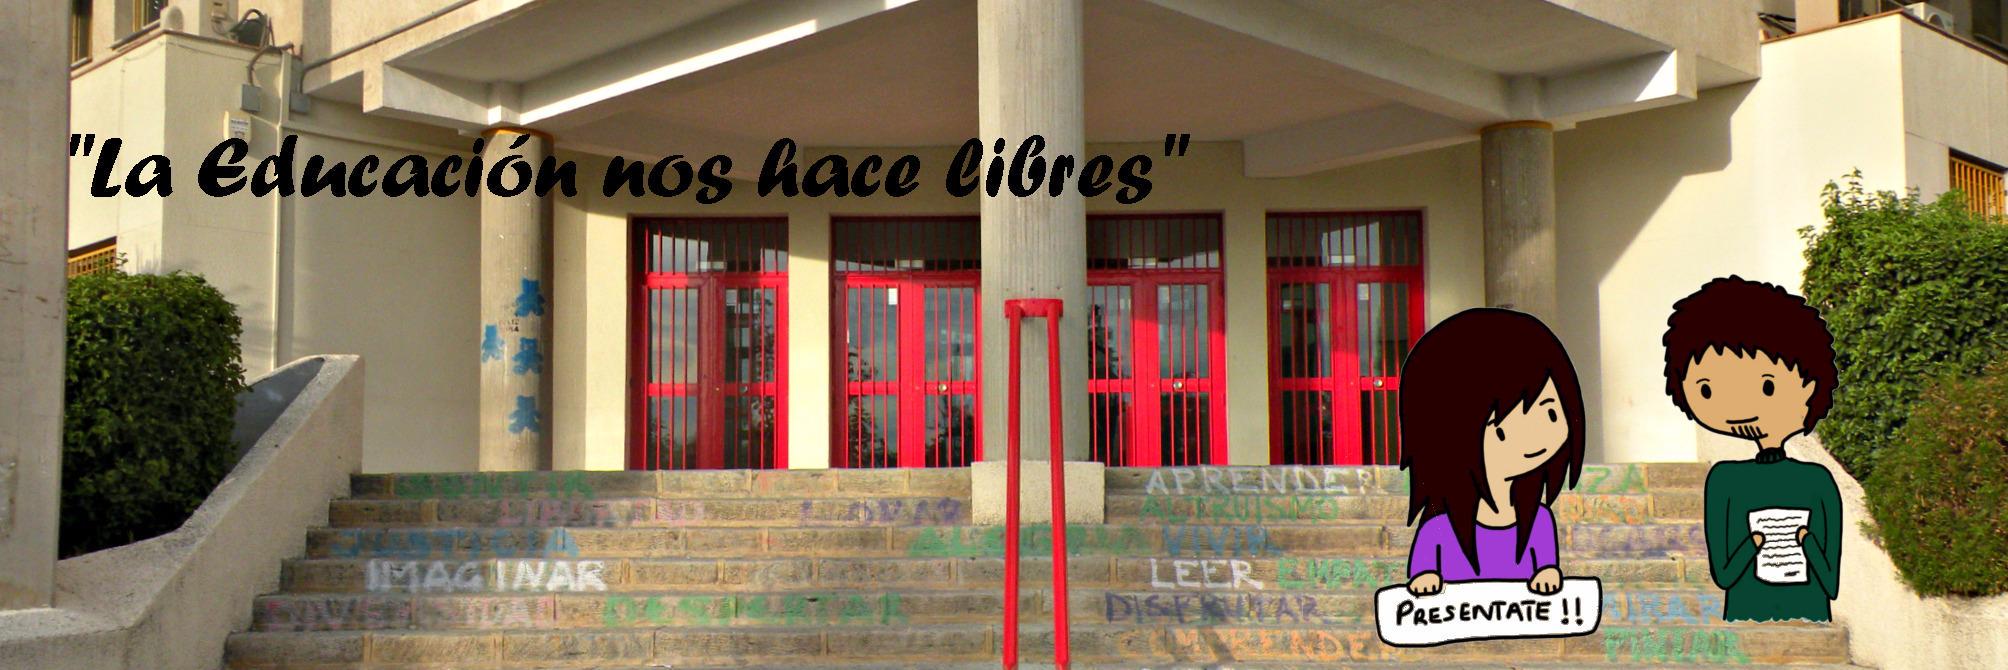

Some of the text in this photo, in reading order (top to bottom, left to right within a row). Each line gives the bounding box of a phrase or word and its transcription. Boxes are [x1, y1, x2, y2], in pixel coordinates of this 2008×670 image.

[1145, 466, 1389, 495] APRENDER
[1162, 524, 1285, 557] VIVIR
[364, 559, 606, 591] IMAGINAR
[1150, 558, 1264, 590] LEER
